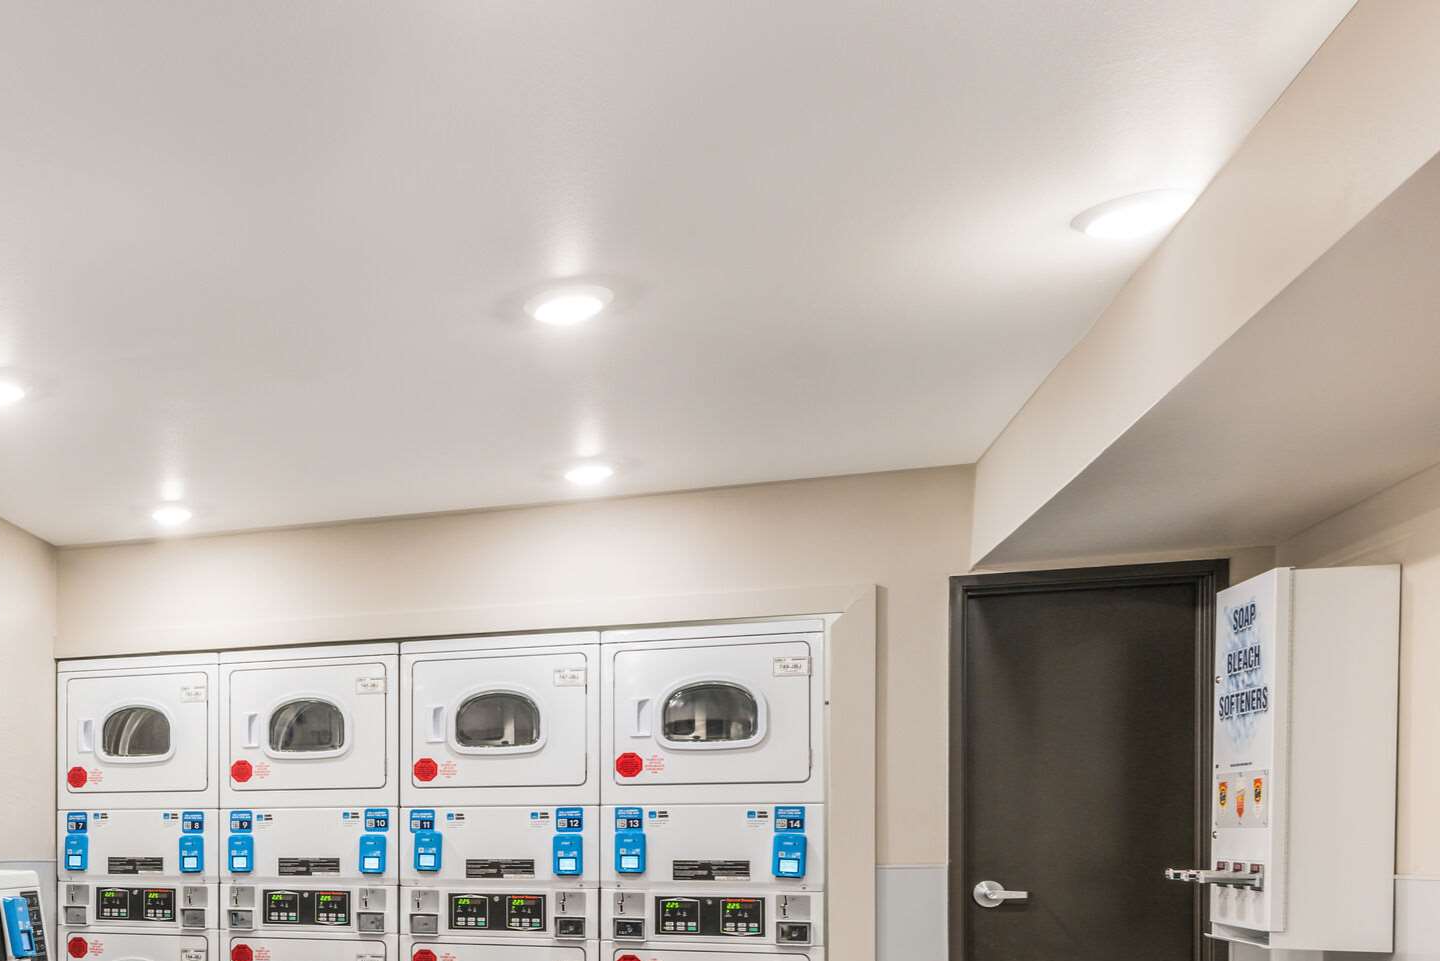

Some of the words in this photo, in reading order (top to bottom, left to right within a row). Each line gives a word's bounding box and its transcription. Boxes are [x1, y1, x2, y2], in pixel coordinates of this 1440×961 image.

[1232, 603, 1257, 631] SOAP
[1226, 645, 1261, 674] BLEACH
[1218, 687, 1269, 717] SOFTENERS
[242, 821, 248, 829] 9
[376, 819, 386, 827] 10
[422, 821, 431, 829] 11
[569, 819, 579, 827] 12
[629, 820, 639, 828] 13
[789, 820, 801, 828] 14
